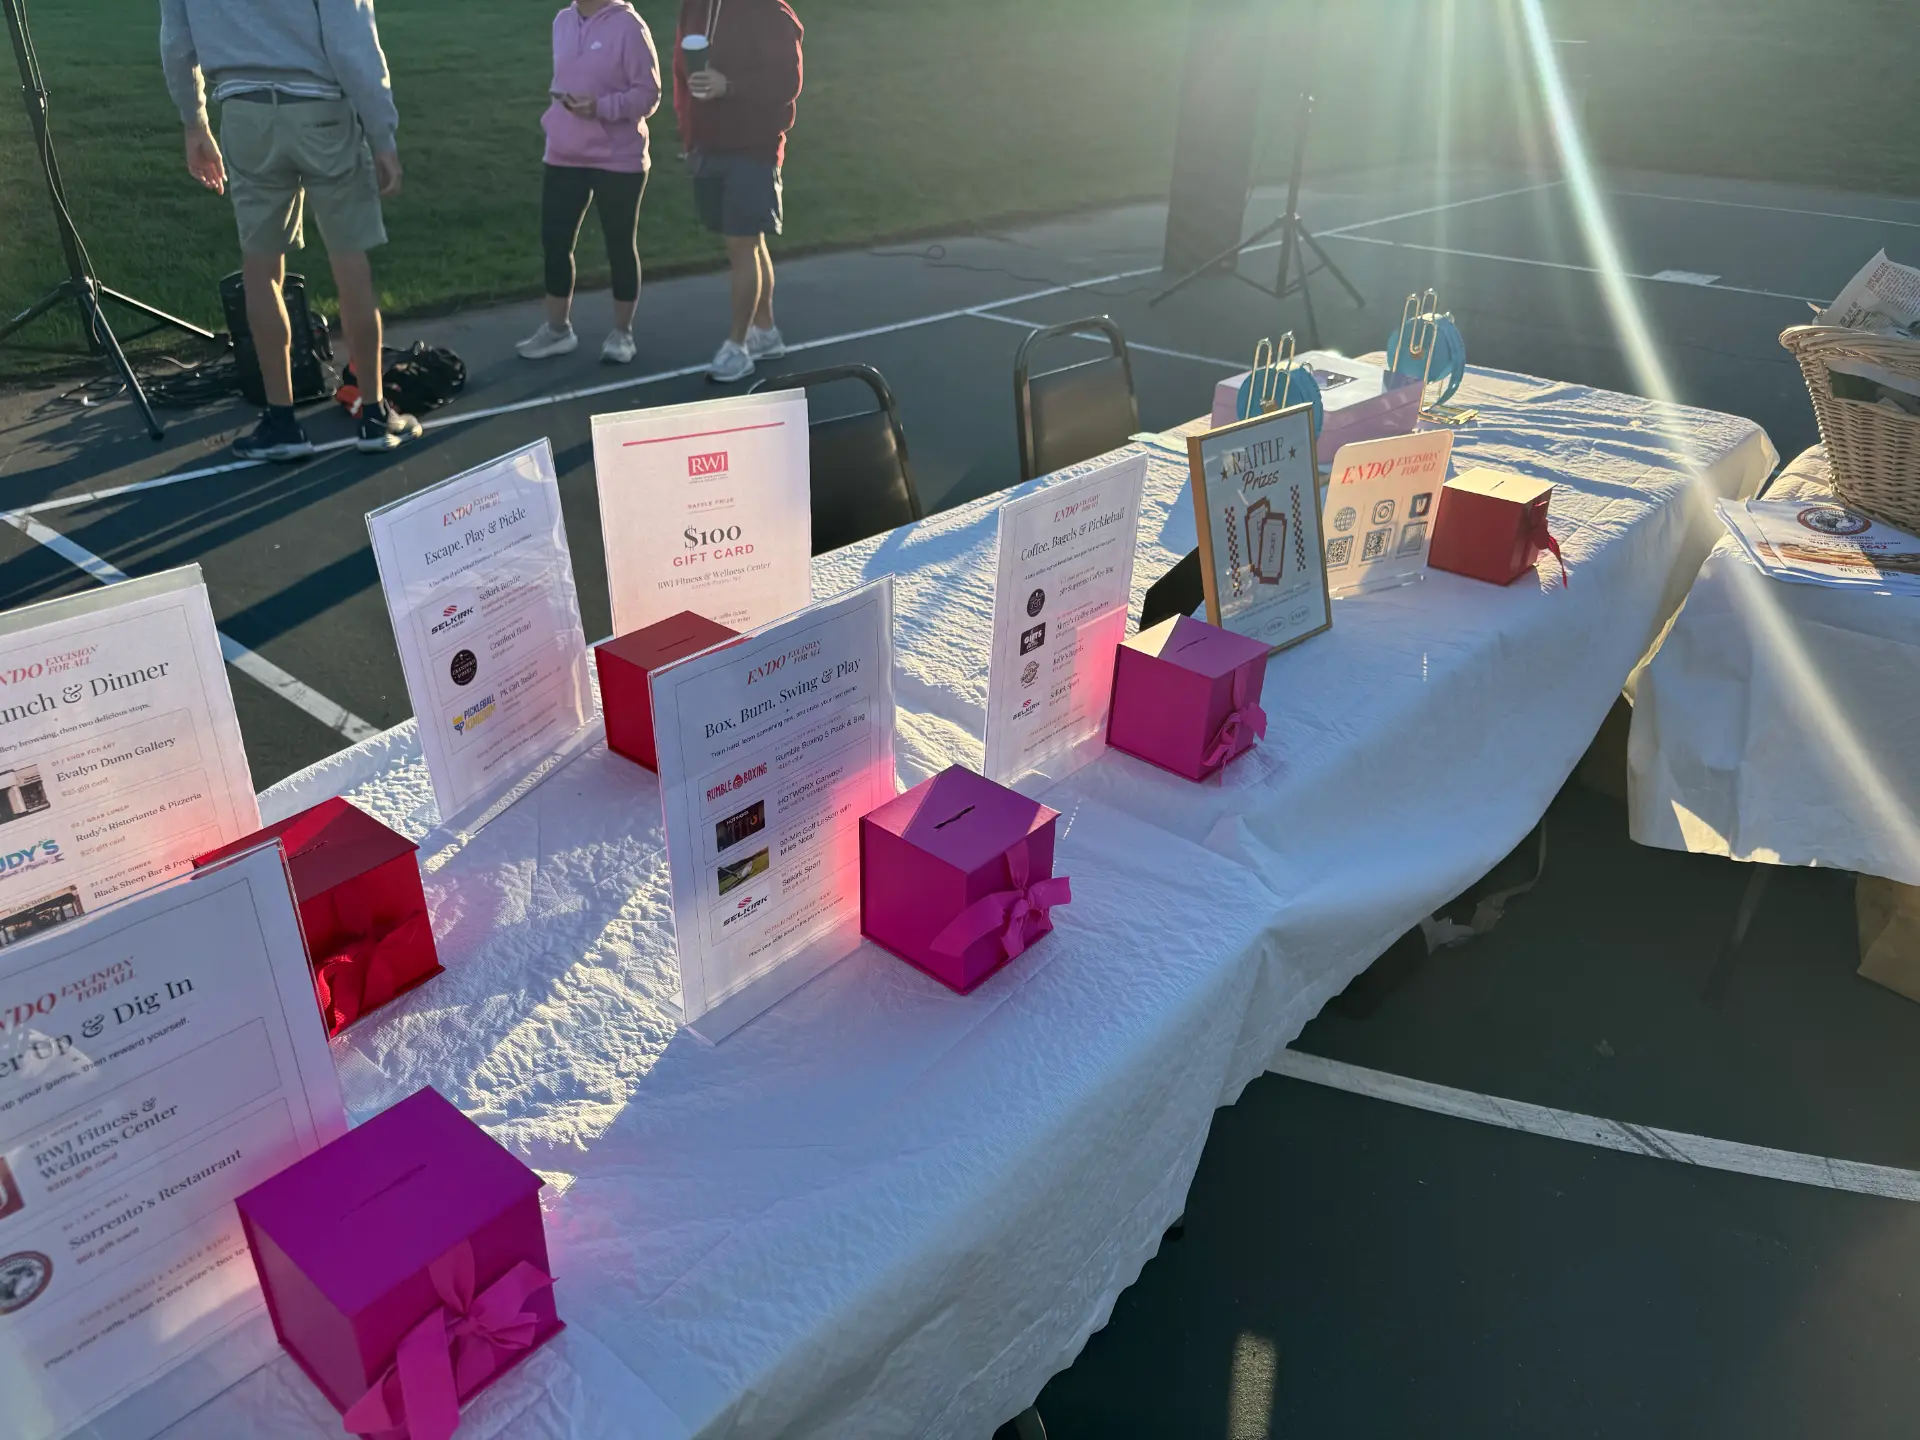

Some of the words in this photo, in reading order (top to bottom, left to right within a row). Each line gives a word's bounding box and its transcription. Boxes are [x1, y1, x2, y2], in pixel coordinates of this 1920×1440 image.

[691, 454, 727, 475] RWJ
[1232, 437, 1286, 476] RAFFLE
[1341, 458, 1395, 485] ENDO
[1242, 469, 1280, 493] Prizes
[443, 502, 473, 527] ENDO
[687, 500, 712, 510] RAFFLE
[714, 497, 735, 507] PRIZE
[1054, 502, 1079, 523] ENDO
[464, 528, 486, 547] Play
[487, 519, 497, 535] &
[499, 506, 527, 530] Pickle
[683, 524, 742, 551] $100
[1021, 541, 1050, 562] Coffee,
[1052, 527, 1078, 549] Bagels
[1078, 522, 1088, 536] &
[1087, 506, 1125, 533] Pickleball
[672, 552, 709, 567] GIFT
[713, 543, 755, 560] CARD
[1268, 531, 1277, 565] TICKET
[658, 579, 674, 591] RWJ
[674, 574, 704, 588] Fitness
[704, 571, 712, 581] &
[712, 565, 746, 580] Wellness
[746, 561, 772, 573] Center
[1838, 566, 1854, 574] WE
[1855, 568, 1900, 578] DELIVER
[479, 587, 501, 602] Selkirk
[431, 606, 474, 636] SELKIRK
[45, 644, 99, 667] EXCISION
[489, 632, 516, 651] Cranford
[48, 662, 70, 676] FOR
[72, 656, 93, 669] ALL
[747, 654, 786, 686] ENDO
[62, 683, 83, 704] &
[89, 661, 169, 698] Dinner
[464, 694, 496, 720] PICKLEBALL
[704, 716, 737, 739] Box,
[740, 698, 777, 724] Burn,
[779, 676, 818, 704] Swing
[821, 668, 834, 685] &
[836, 658, 861, 680] Play
[1012, 701, 1041, 721] SELKIRK
[19, 731, 60, 749] browsing,
[60, 724, 78, 736] then
[79, 720, 94, 729] two
[94, 709, 129, 725] delicious
[56, 762, 99, 783] Evalyn
[100, 752, 134, 769] Dunn
[135, 737, 176, 757] Gallery
[66, 752, 85, 763] SHOP
[775, 746, 801, 764] Rumble
[801, 733, 824, 749] Boxing
[706, 779, 733, 802] RUMBLE
[743, 762, 768, 786] BOXING
[777, 780, 815, 807] HOTWORX
[75, 825, 108, 844] Rudy's
[159, 804, 167, 813] &
[167, 792, 203, 810] Pizzeria
[779, 831, 802, 847] 90-Min
[802, 822, 816, 836] Golf
[816, 809, 839, 828] Lesson
[93, 883, 119, 900] Black
[119, 873, 147, 892] Sheep
[147, 866, 164, 880] Bar
[164, 863, 172, 872] &
[782, 870, 803, 887] Selkirk
[804, 859, 821, 873] Sport
[723, 895, 769, 928] SELKIRK
[61, 955, 135, 998] EXCISION
[77, 981, 109, 1003] FOR
[111, 968, 138, 989] ALL
[31, 1033, 74, 1061] Up
[82, 1013, 105, 1039] &
[112, 992, 161, 1026] Dig
[165, 976, 195, 1001] In
[82, 1057, 108, 1073] then
[108, 1037, 146, 1061] reward
[146, 1016, 191, 1045] yourself.
[33, 1141, 74, 1168] RWJ
[77, 1110, 139, 1148] Fitness
[140, 1096, 158, 1113] &
[40, 1139, 119, 1180] Wellness
[121, 1104, 179, 1140] Center
[68, 1198, 157, 1251] Sorrento's
[158, 1148, 243, 1203] Restaurant
[215, 1254, 234, 1269] box
[235, 1247, 246, 1258] to
